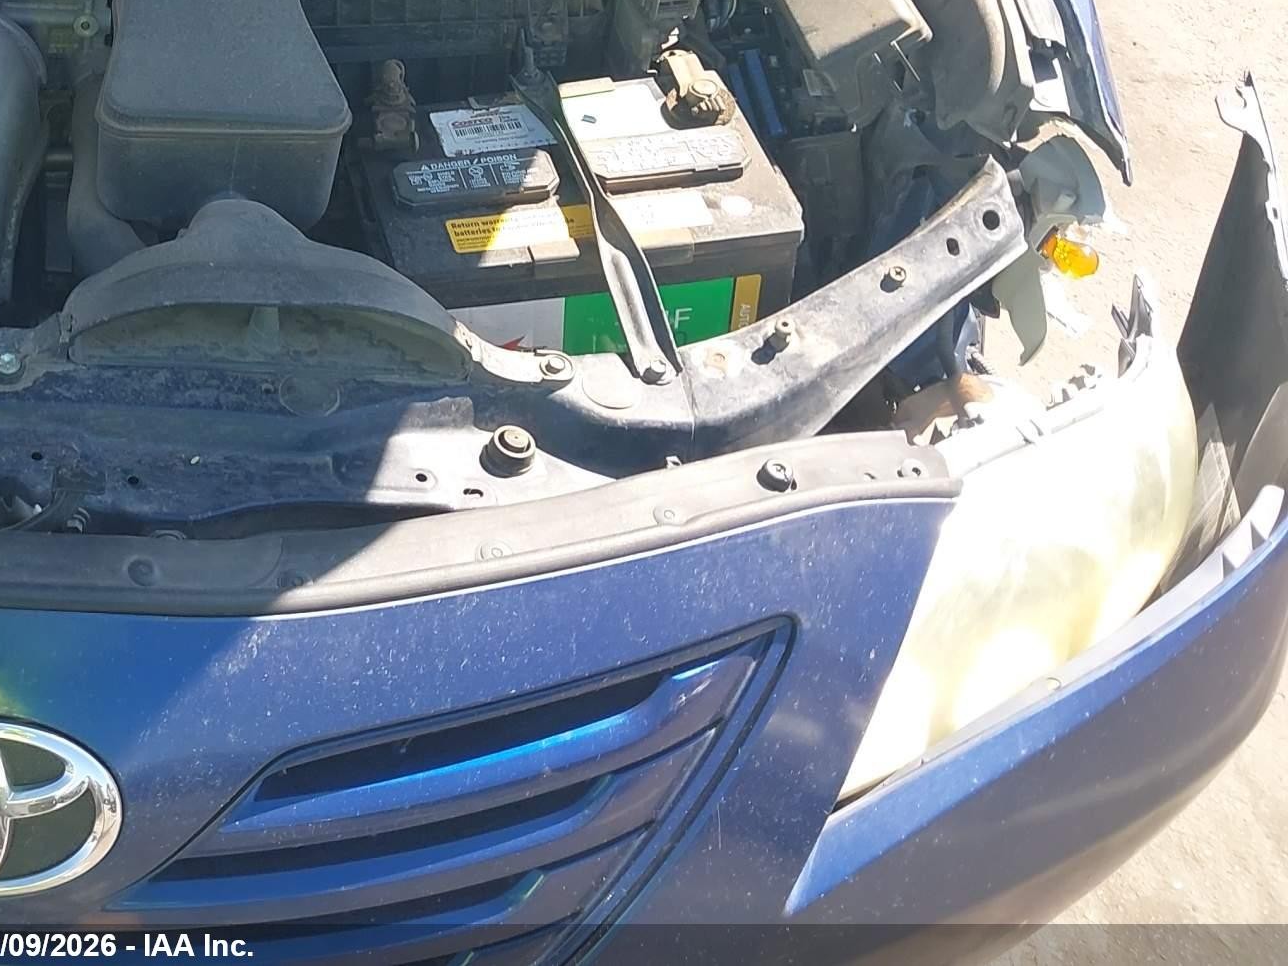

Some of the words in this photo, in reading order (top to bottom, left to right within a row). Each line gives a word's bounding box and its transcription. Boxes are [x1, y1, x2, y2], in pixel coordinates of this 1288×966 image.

[430, 159, 472, 171] DANGER
[480, 153, 518, 165] POISON
[450, 220, 480, 230] Return
[454, 226, 492, 237] batteries
